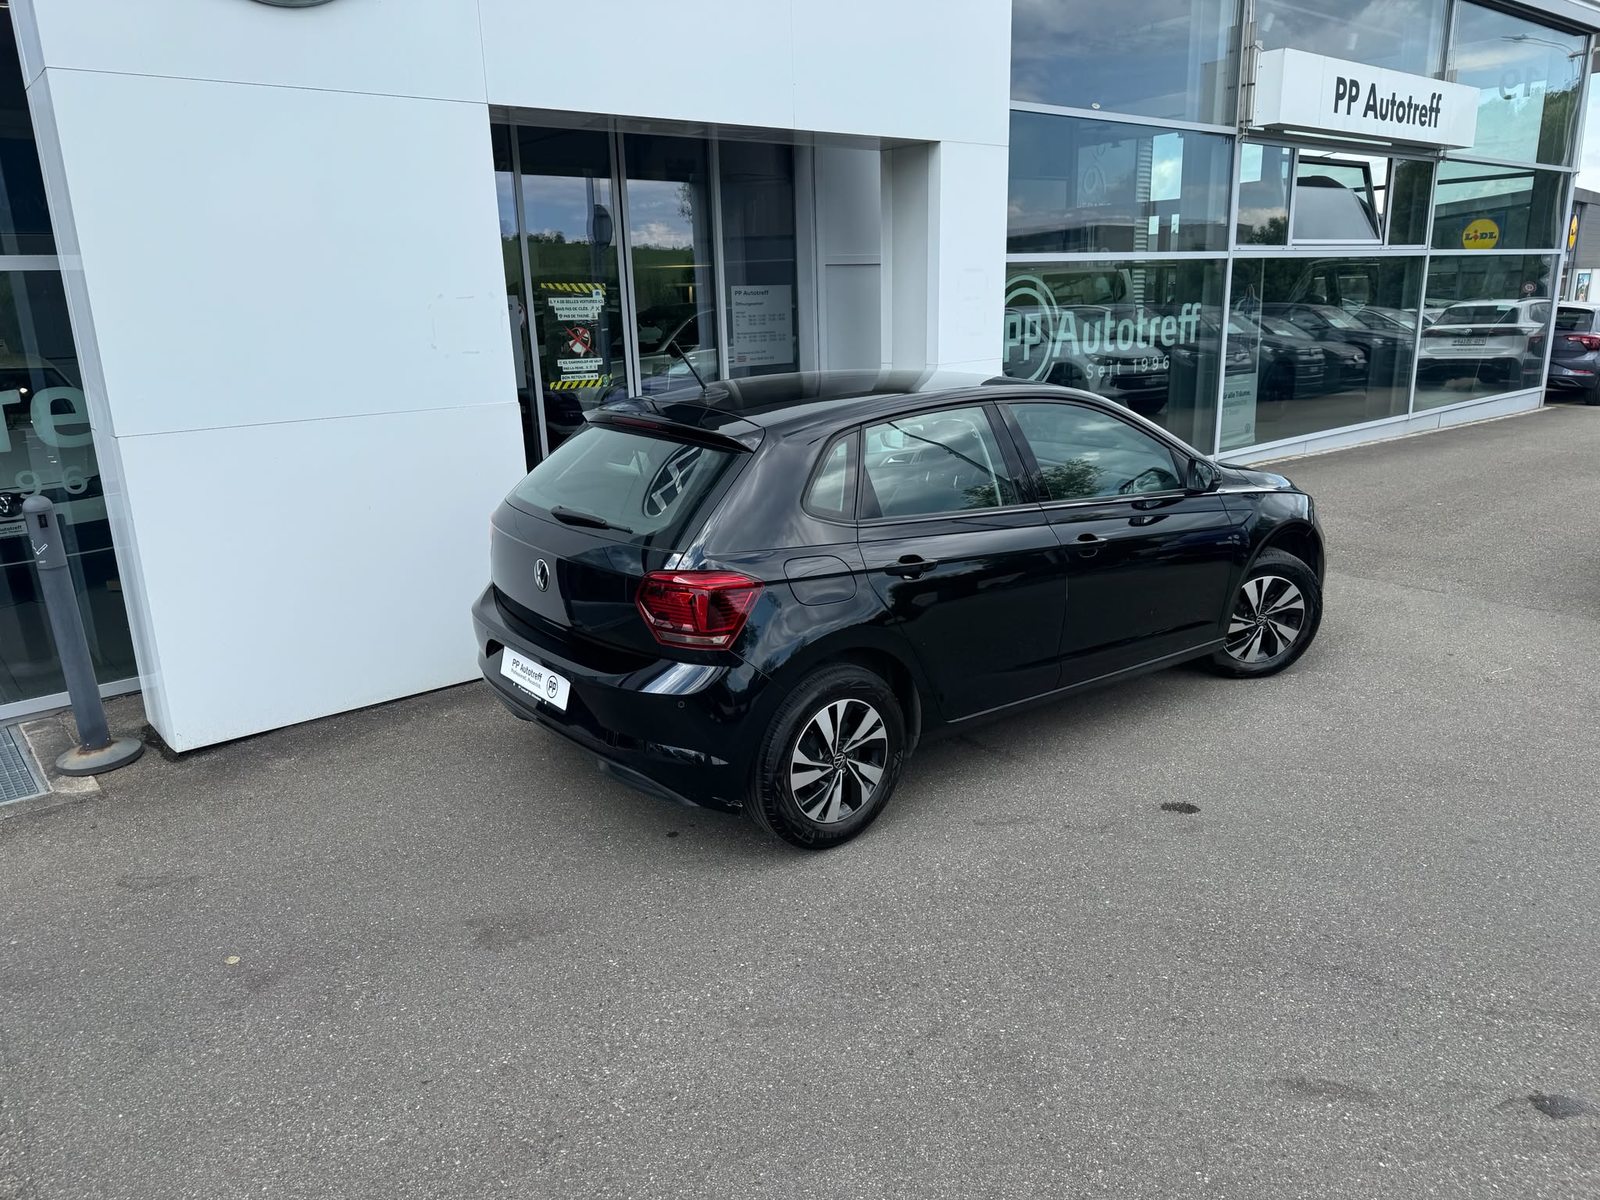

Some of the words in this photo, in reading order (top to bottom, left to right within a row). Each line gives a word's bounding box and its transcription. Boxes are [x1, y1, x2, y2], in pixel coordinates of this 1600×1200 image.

[1333, 76, 1360, 115] PP
[1362, 83, 1442, 128] Autotreff
[1003, 312, 1042, 363] PP
[1052, 302, 1201, 358] Autotreff
[1086, 361, 1121, 380] Seit
[1133, 355, 1170, 374] 1996
[512, 658, 520, 668] PP
[520, 664, 543, 682] Autotreff
